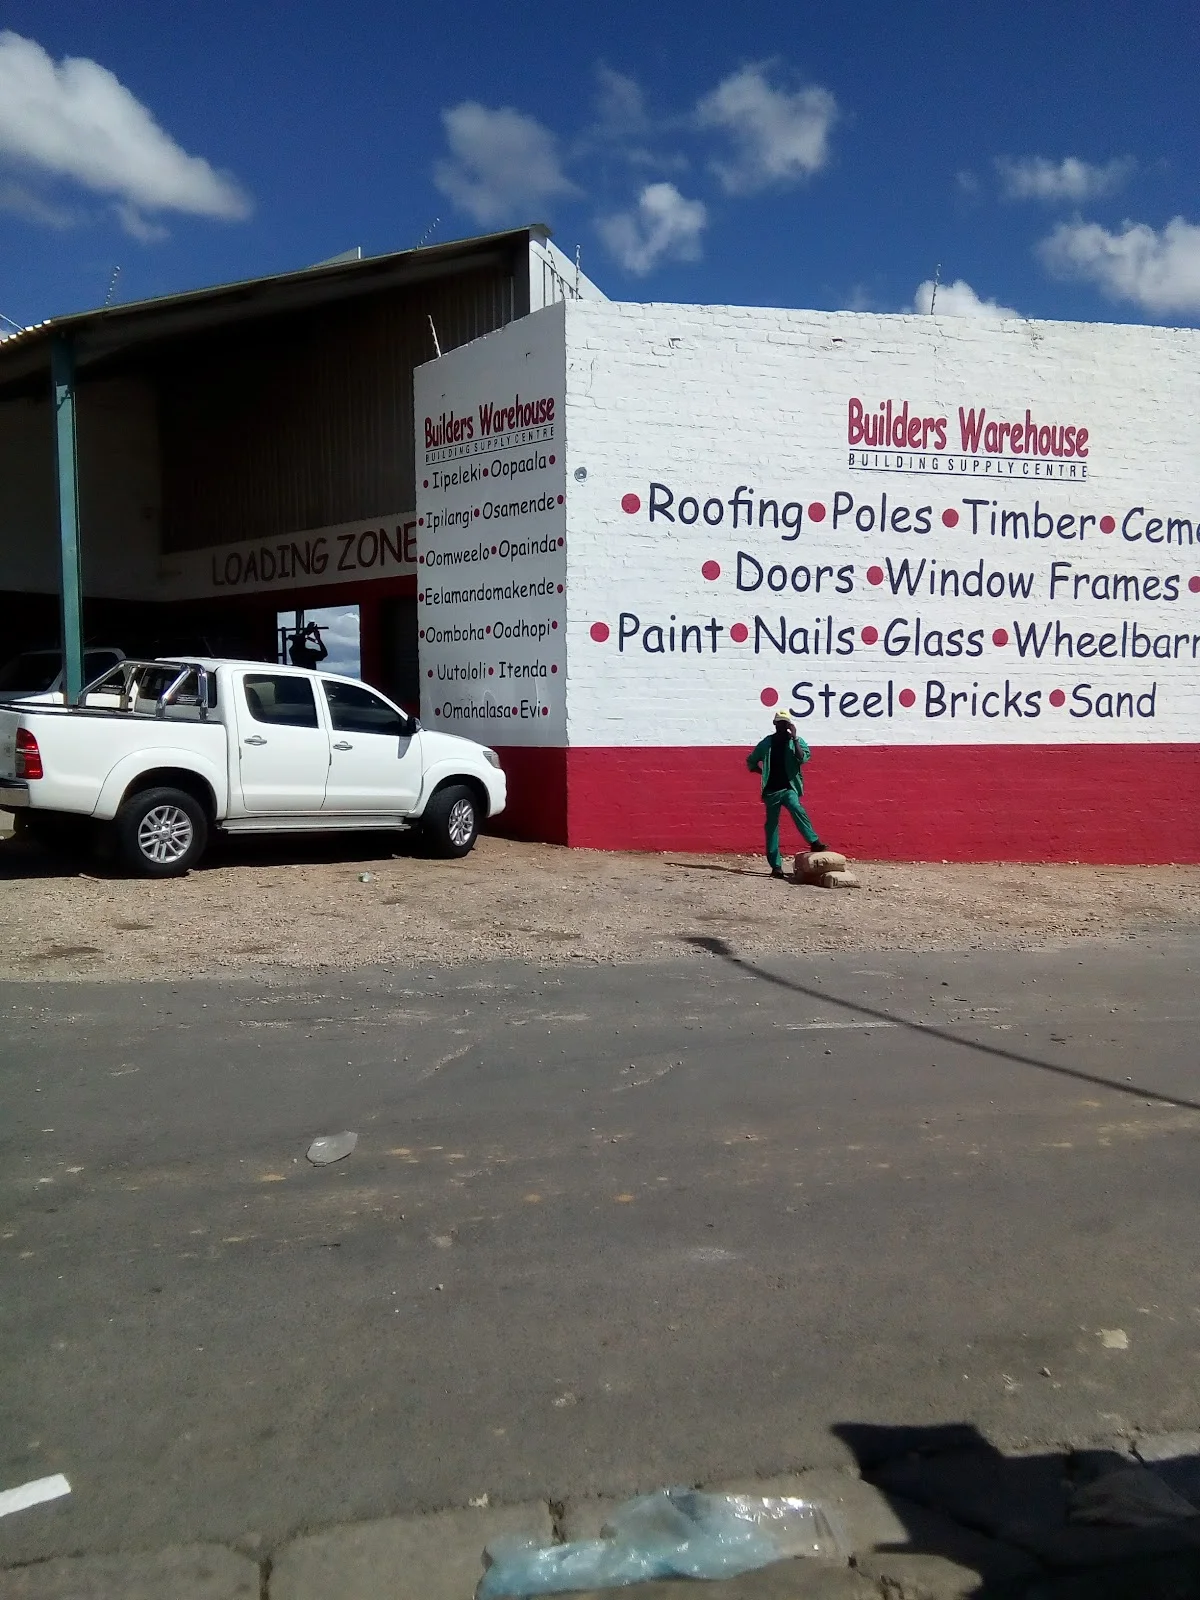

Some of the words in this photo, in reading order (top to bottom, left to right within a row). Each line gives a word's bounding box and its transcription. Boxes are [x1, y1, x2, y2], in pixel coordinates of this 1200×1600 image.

[425, 411, 473, 448] Builders
[479, 394, 555, 435] Warehouse
[848, 398, 947, 450] Builders
[958, 406, 1089, 458] Warehouse
[425, 444, 470, 463] BUILDING
[474, 436, 511, 452] SUPPLY
[515, 427, 554, 443] CENTRE
[491, 451, 547, 480] Oopaala
[848, 453, 939, 470] BUILDING
[948, 458, 1015, 474] SUPPLY
[1022, 463, 1088, 478] CENTRE
[426, 505, 473, 533] Ipilangi
[482, 492, 555, 520] Osamende
[649, 482, 803, 541] Roofing
[833, 491, 932, 534] Poles
[962, 498, 1096, 541] Timber
[1121, 506, 1200, 546] Cem
[212, 537, 330, 586] LOADING
[336, 521, 417, 572] ZONE
[425, 543, 490, 567] Oomweelo
[498, 534, 557, 562] Opainda
[425, 576, 554, 606] Eelamandomakende
[736, 550, 855, 594] Doors
[885, 556, 1035, 599] Window
[1050, 561, 1180, 602] Frames
[425, 623, 485, 643] Oomboha
[492, 618, 550, 642] Oodhopi
[618, 612, 724, 654] Paint
[754, 614, 855, 656] Nails
[883, 617, 984, 657] Glass
[436, 661, 486, 681] Uutololi
[498, 659, 547, 679] Itenda
[442, 700, 512, 719] Omahalasa
[520, 699, 541, 718] Evi
[788, 680, 893, 718] Steel
[925, 679, 1042, 718] Bricks
[1069, 681, 1157, 718] Sand
